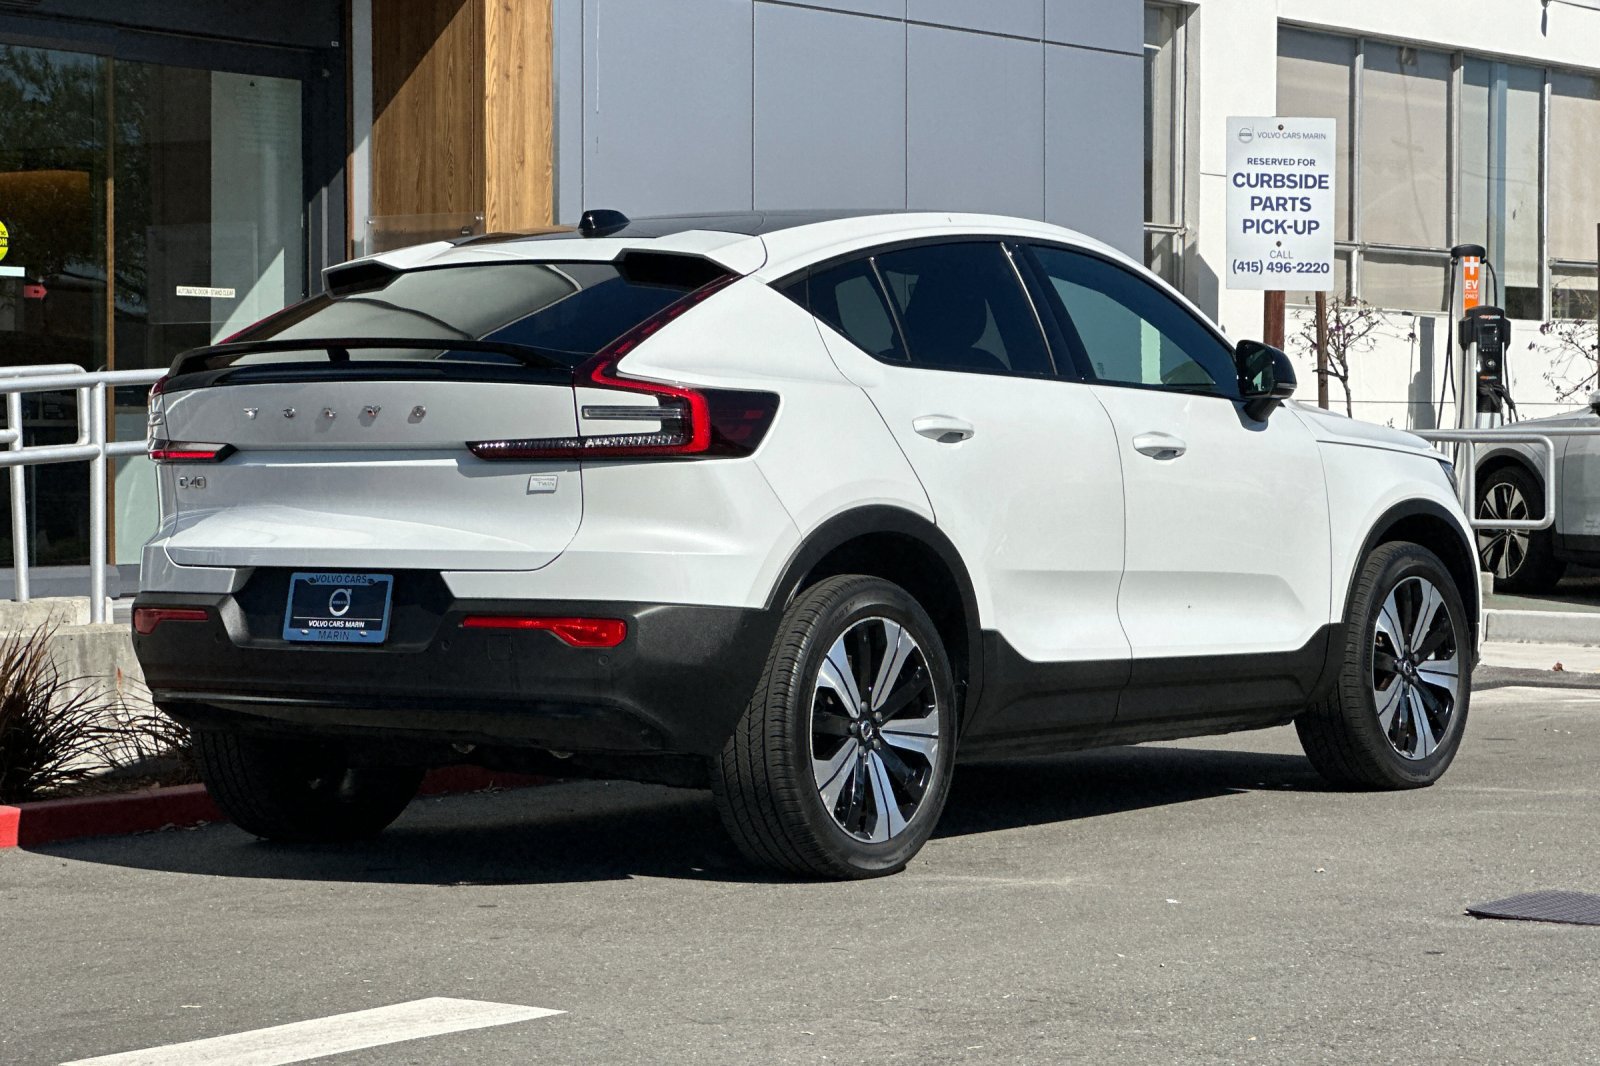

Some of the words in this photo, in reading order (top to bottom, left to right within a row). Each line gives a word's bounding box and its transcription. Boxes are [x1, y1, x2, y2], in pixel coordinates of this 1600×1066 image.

[1257, 131, 1280, 139] VOLVO
[1302, 132, 1326, 140] MARIN
[1247, 157, 1295, 166] RESERVED
[1297, 158, 1316, 167] FOR
[1232, 172, 1329, 190] CURBSIDE
[1250, 196, 1312, 212] PARTS
[1242, 219, 1320, 235] PICK-UP
[1269, 250, 1293, 259] CALL
[1232, 259, 1263, 275] (415)
[1266, 261, 1330, 274] 496-2220
[1465, 279, 1478, 289] EV
[179, 476, 206, 488] C40
[315, 574, 343, 583] VOLVO
[344, 575, 367, 584] CARS
[328, 620, 344, 628] CARS
[318, 630, 350, 640] MARIN
